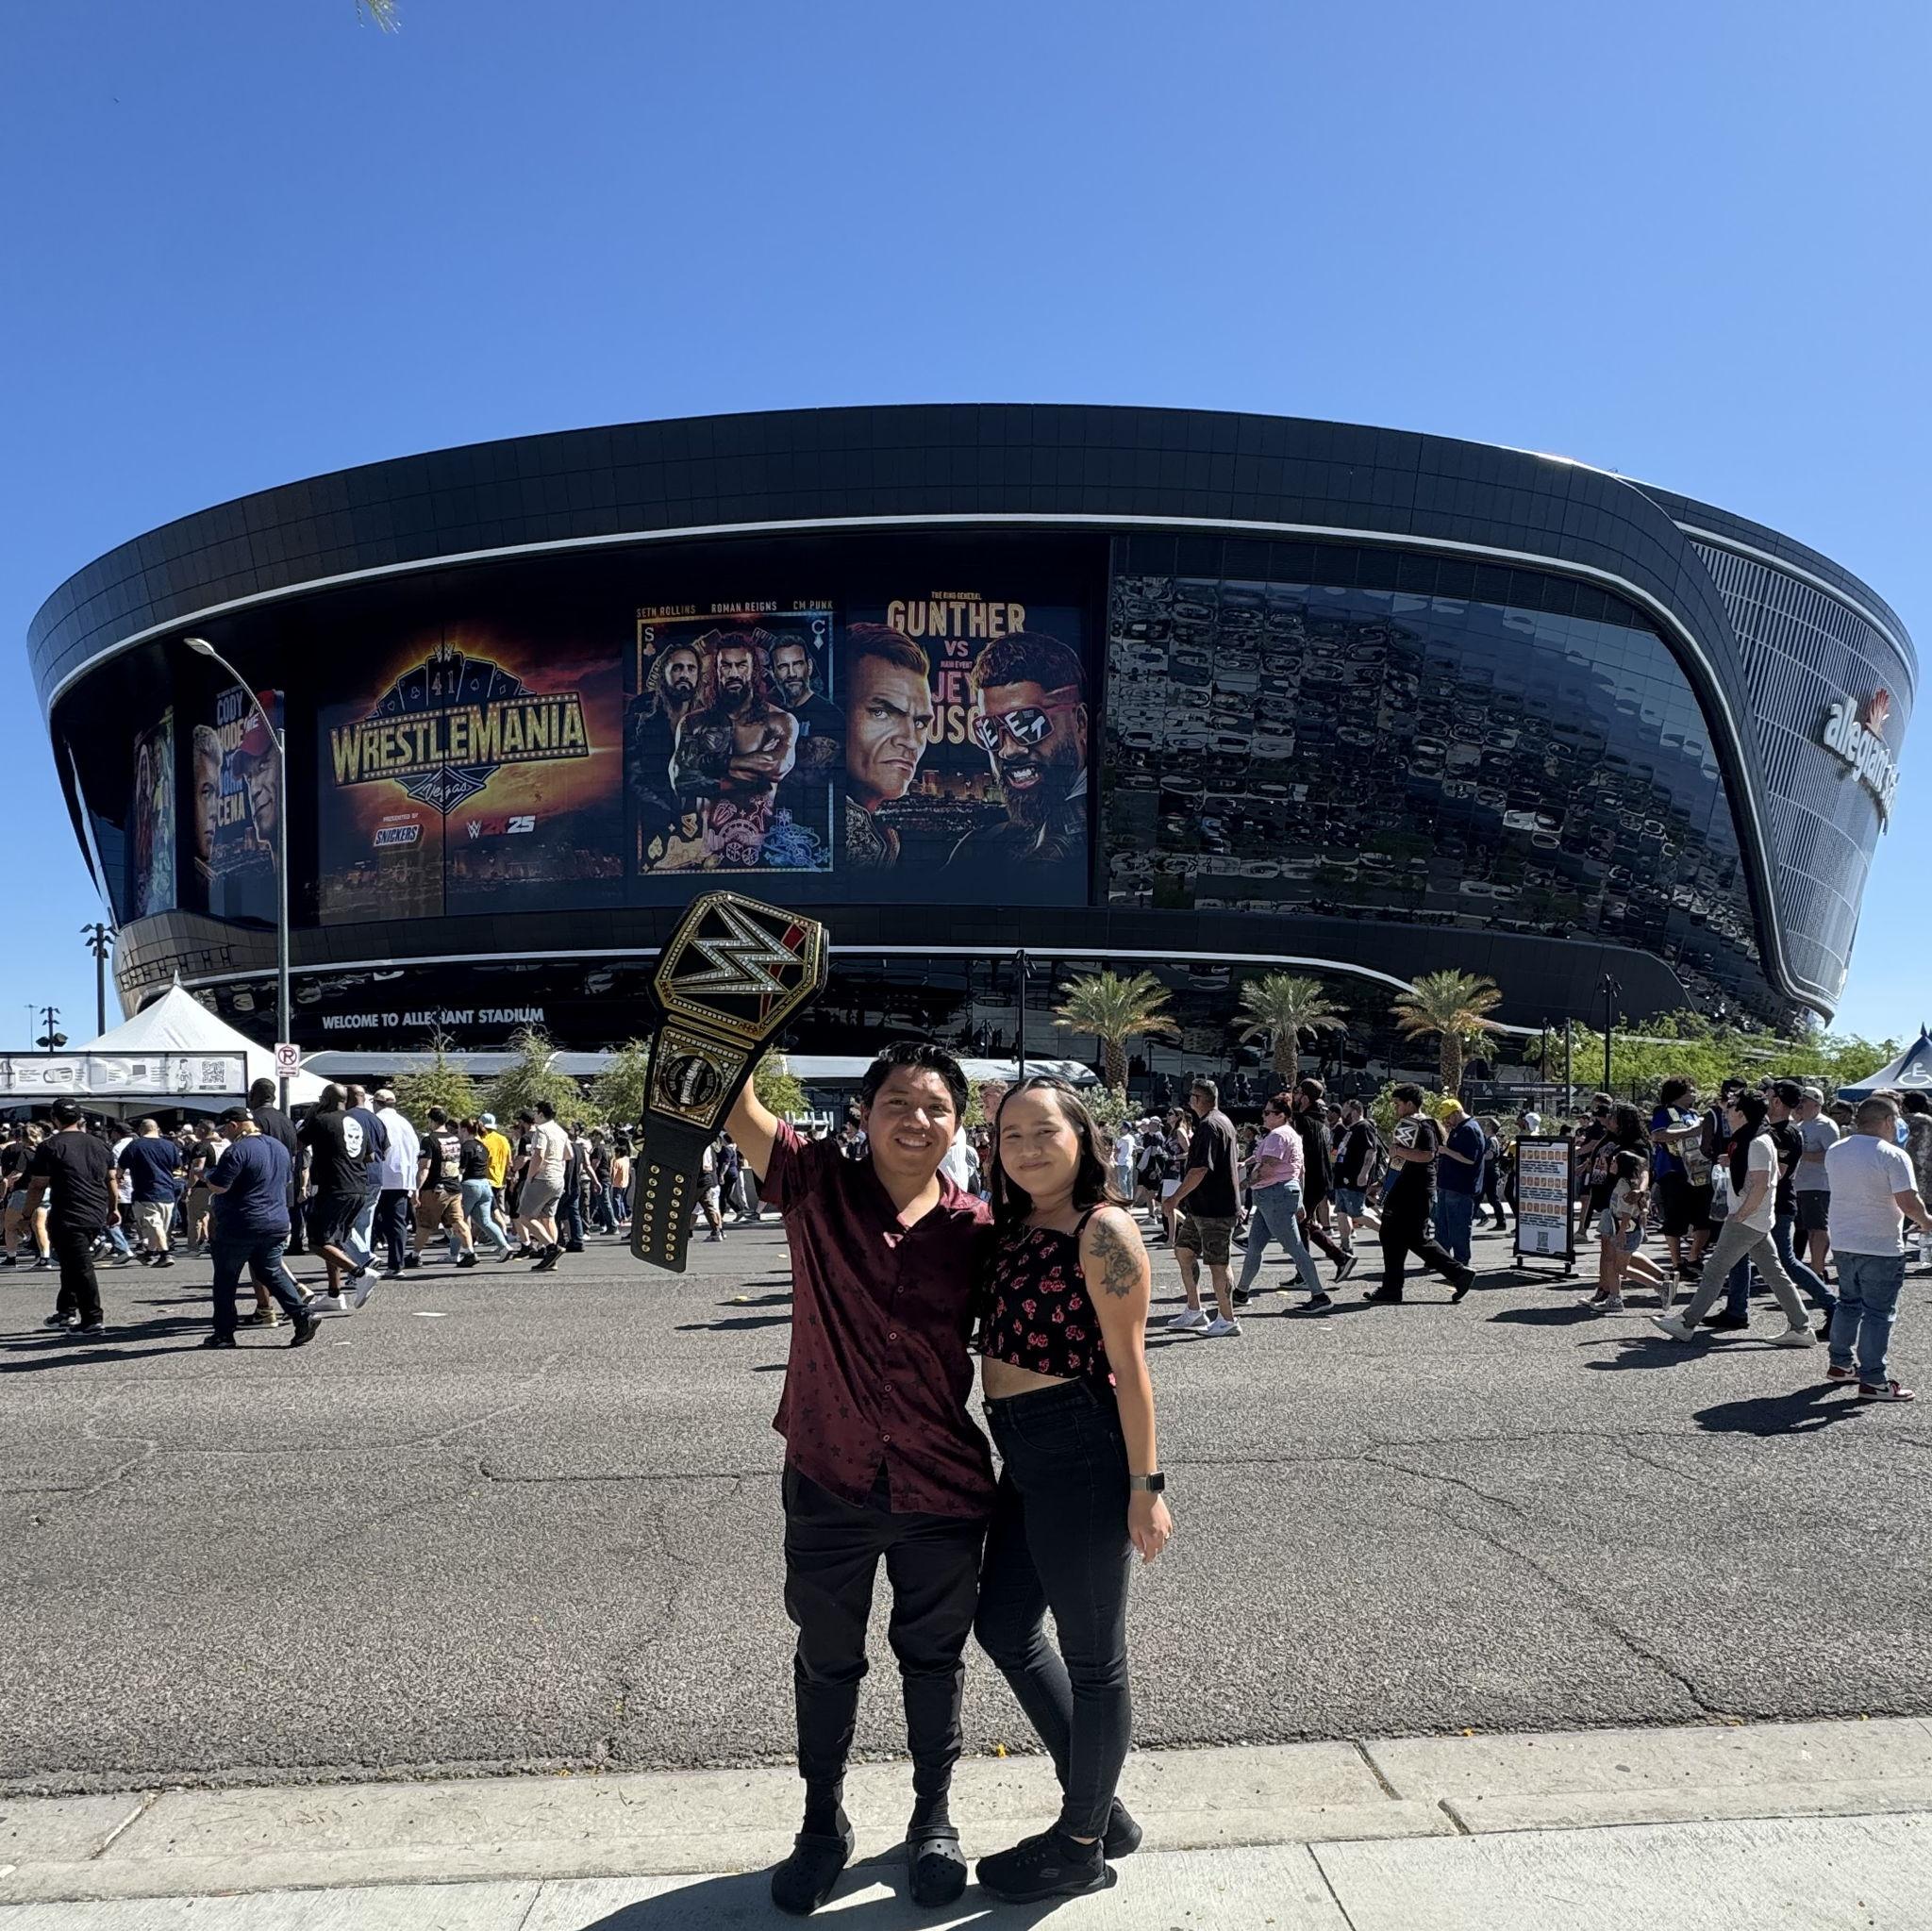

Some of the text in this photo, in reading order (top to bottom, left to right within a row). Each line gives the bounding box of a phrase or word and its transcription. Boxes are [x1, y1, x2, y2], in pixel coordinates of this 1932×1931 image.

[636, 605, 696, 618] SETH ROLLINS
[711, 601, 777, 613] ROMAN REIGNS
[792, 599, 834, 610] CM PUNK
[887, 600, 1026, 638] GUNTHER
[944, 640, 969, 658] VS
[431, 670, 456, 696] 41
[217, 690, 243, 725] CODY
[217, 791, 246, 827] CENA
[375, 824, 419, 845] SNICKERS
[322, 1007, 544, 1029] WELCOME TO ALLEIANT STADIUM
